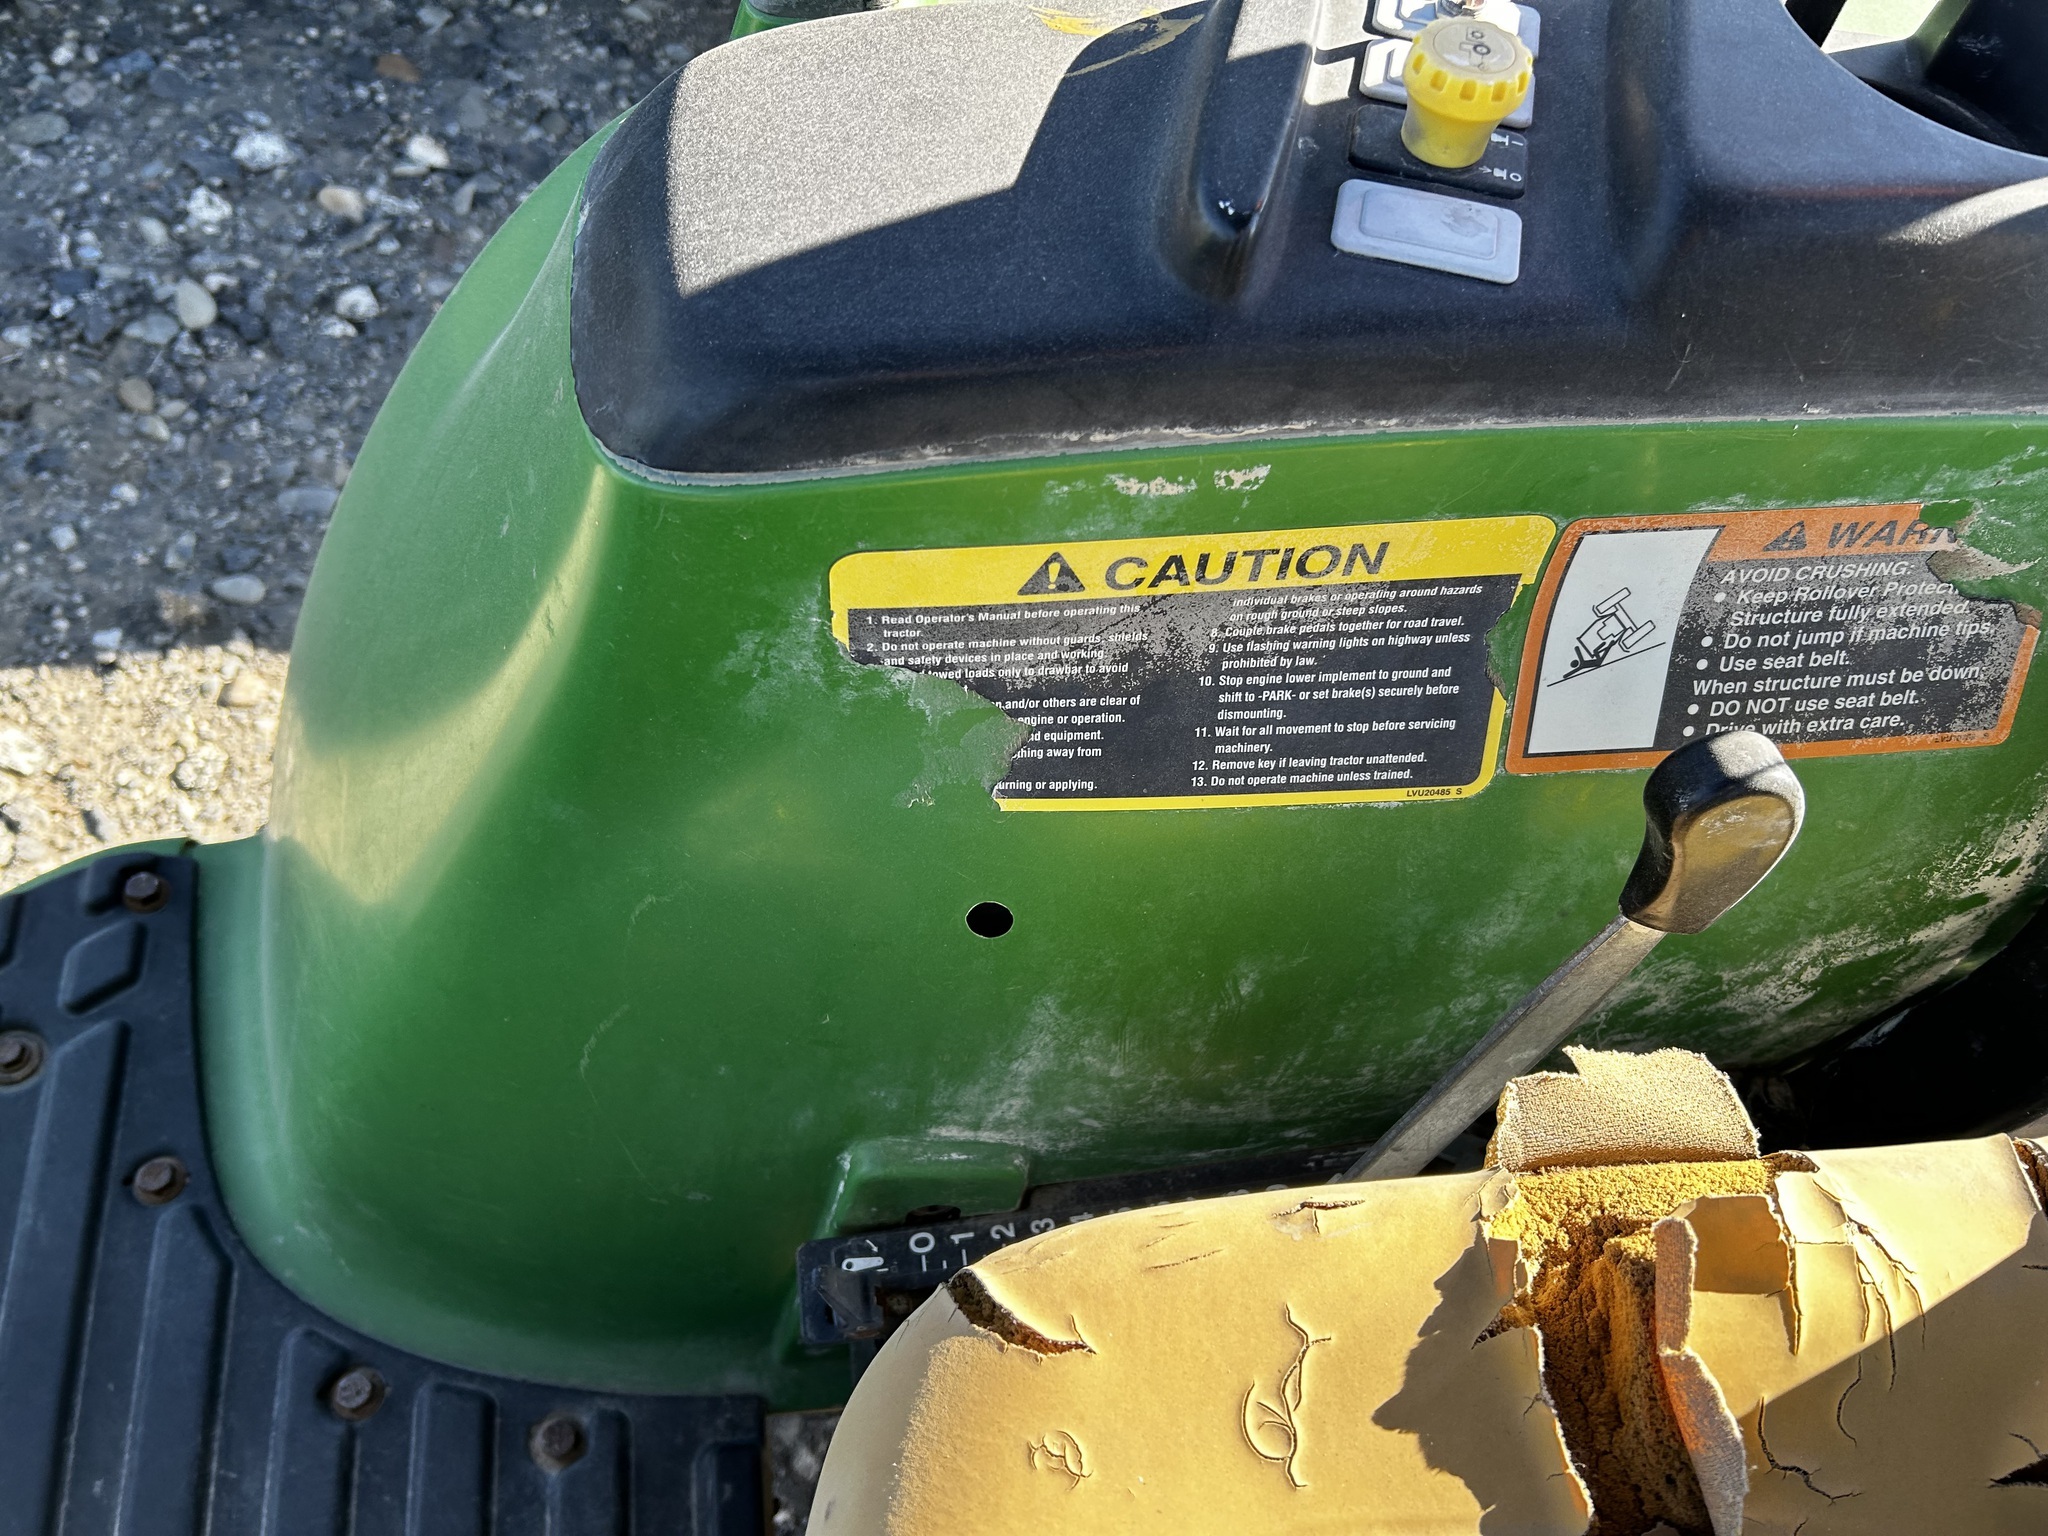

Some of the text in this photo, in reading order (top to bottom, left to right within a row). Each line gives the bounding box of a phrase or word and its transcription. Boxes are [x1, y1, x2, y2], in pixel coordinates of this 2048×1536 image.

[1104, 541, 1390, 590] CAUTION
[1720, 561, 1916, 585] AVOID CRUSHING:
[1233, 595, 1288, 607] individual
[1290, 593, 1327, 604] brakes
[1330, 593, 1342, 601] or
[1399, 586, 1438, 597] around
[1440, 584, 1483, 595] hazards
[1736, 584, 1879, 607] Keep Rollover
[866, 604, 1141, 626] 1. Read Operator's Manual before operating this
[1229, 604, 1408, 622] on rough ground or steep slopes.
[1730, 600, 1971, 627] Structure fully extended.
[883, 629, 924, 638] tractor.
[1210, 628, 1221, 638] 8.
[1265, 624, 1296, 635] brake
[1299, 622, 1336, 635] pedals
[1338, 620, 1385, 633] together
[1386, 619, 1401, 630] for
[1403, 618, 1429, 628] road
[1430, 616, 1465, 627] travel.
[1723, 623, 1950, 650] Do not jump if machine
[866, 631, 1149, 653] 2. Do not operate machine without guards, shields
[1208, 632, 1471, 653] 9. Use flashing warning lights on highway unless
[884, 656, 905, 666] and
[908, 654, 943, 667] safety
[945, 653, 988, 664] devices
[990, 652, 1001, 661] in
[1004, 650, 1034, 664] place
[1037, 650, 1058, 660] and
[1221, 655, 1318, 671] prohibited by law.
[1719, 656, 1757, 672] Use
[1762, 653, 1805, 670] seat
[965, 662, 1129, 678] loads only to drawbar to avoid
[1199, 666, 1452, 688] 10. Stop engine lower implement to ground and
[1693, 667, 1925, 696] When structure must be
[1006, 698, 1041, 710] and/or
[1042, 697, 1077, 708] others
[1079, 697, 1097, 707] are
[1100, 695, 1127, 706] clear
[1129, 694, 1142, 705] of
[1218, 684, 1460, 703] shift to -PARK- or set brake(s) securely before
[1709, 689, 1920, 717] DO NOT use seat belt.
[1057, 714, 1069, 724] or
[1071, 712, 1126, 726] operation.
[1217, 708, 1287, 721] dismounting.
[1762, 718, 1802, 735] with
[1806, 717, 1855, 733] extra
[1859, 714, 1905, 729] care.
[1043, 729, 1105, 743] equipment.
[1194, 717, 1457, 738] 11. Wait for all movement to stop before servicing
[1046, 747, 1102, 759] away from
[1214, 742, 1273, 754] machinery.
[1192, 751, 1428, 771] 12. Remove key if leaving tractor unattended.
[1035, 779, 1098, 792] or applying.
[1190, 768, 1414, 787] 13. Do not operate machine unless trained.
[1406, 787, 1463, 798] LVU20485 S
[950, 1232, 975, 1245] 1
[990, 1222, 1016, 1240] 2
[1030, 1217, 1056, 1235] 3
